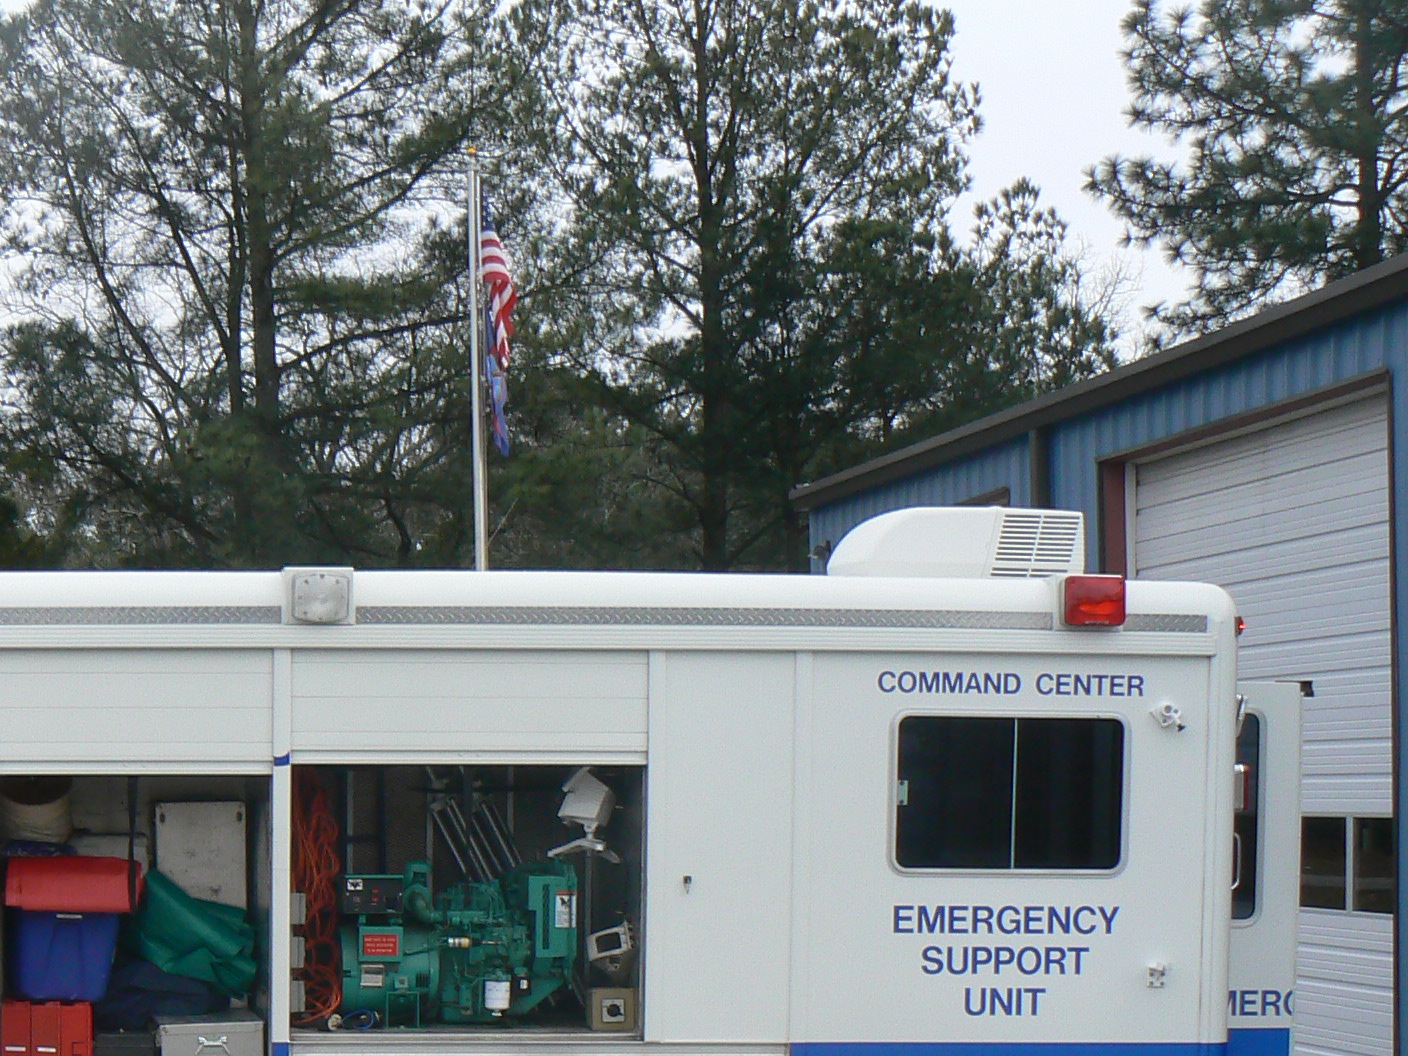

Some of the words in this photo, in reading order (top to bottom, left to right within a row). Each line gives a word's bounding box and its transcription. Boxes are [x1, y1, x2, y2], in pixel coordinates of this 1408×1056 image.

[877, 671, 1021, 695] COMMAND
[1036, 673, 1145, 697] CENTER
[892, 905, 1121, 935] EMERGENCY
[920, 945, 1090, 976] SUPPORT
[963, 987, 1047, 1017] UNIT
